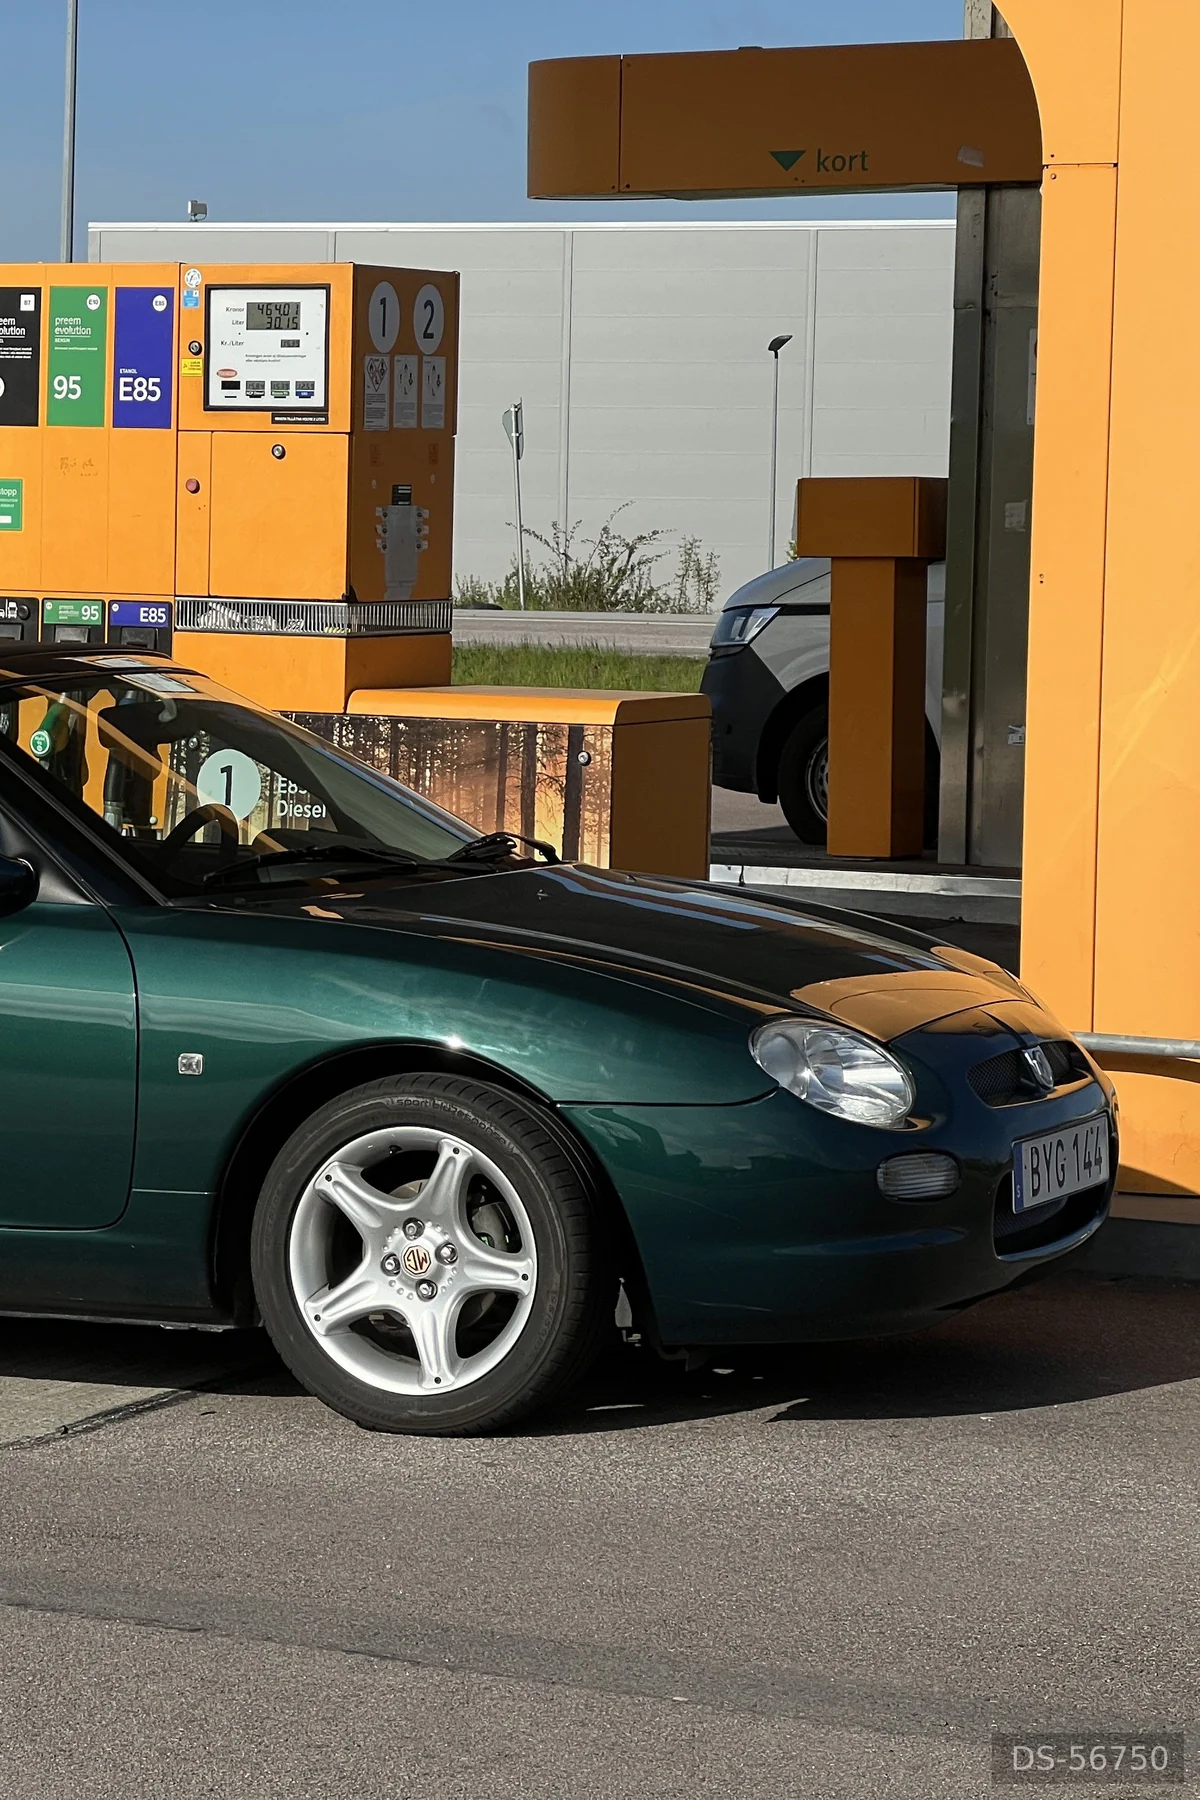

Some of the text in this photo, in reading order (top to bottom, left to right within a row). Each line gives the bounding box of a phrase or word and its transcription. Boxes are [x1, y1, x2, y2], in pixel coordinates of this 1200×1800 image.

[816, 147, 870, 173] kort
[55, 317, 81, 326] preem
[380, 297, 387, 337] 1
[423, 299, 435, 339] 2
[54, 326, 91, 335] evolution
[53, 375, 82, 400] 95
[119, 376, 162, 402] E85
[81, 605, 99, 621] 95
[140, 607, 166, 623] E85
[220, 765, 232, 806] 1
[279, 777, 308, 795] E8
[277, 800, 327, 818] Diesel
[1030, 1126, 1103, 1198] BYG 144
[1015, 1184, 1021, 1198] S
[406, 1248, 428, 1271] MG
